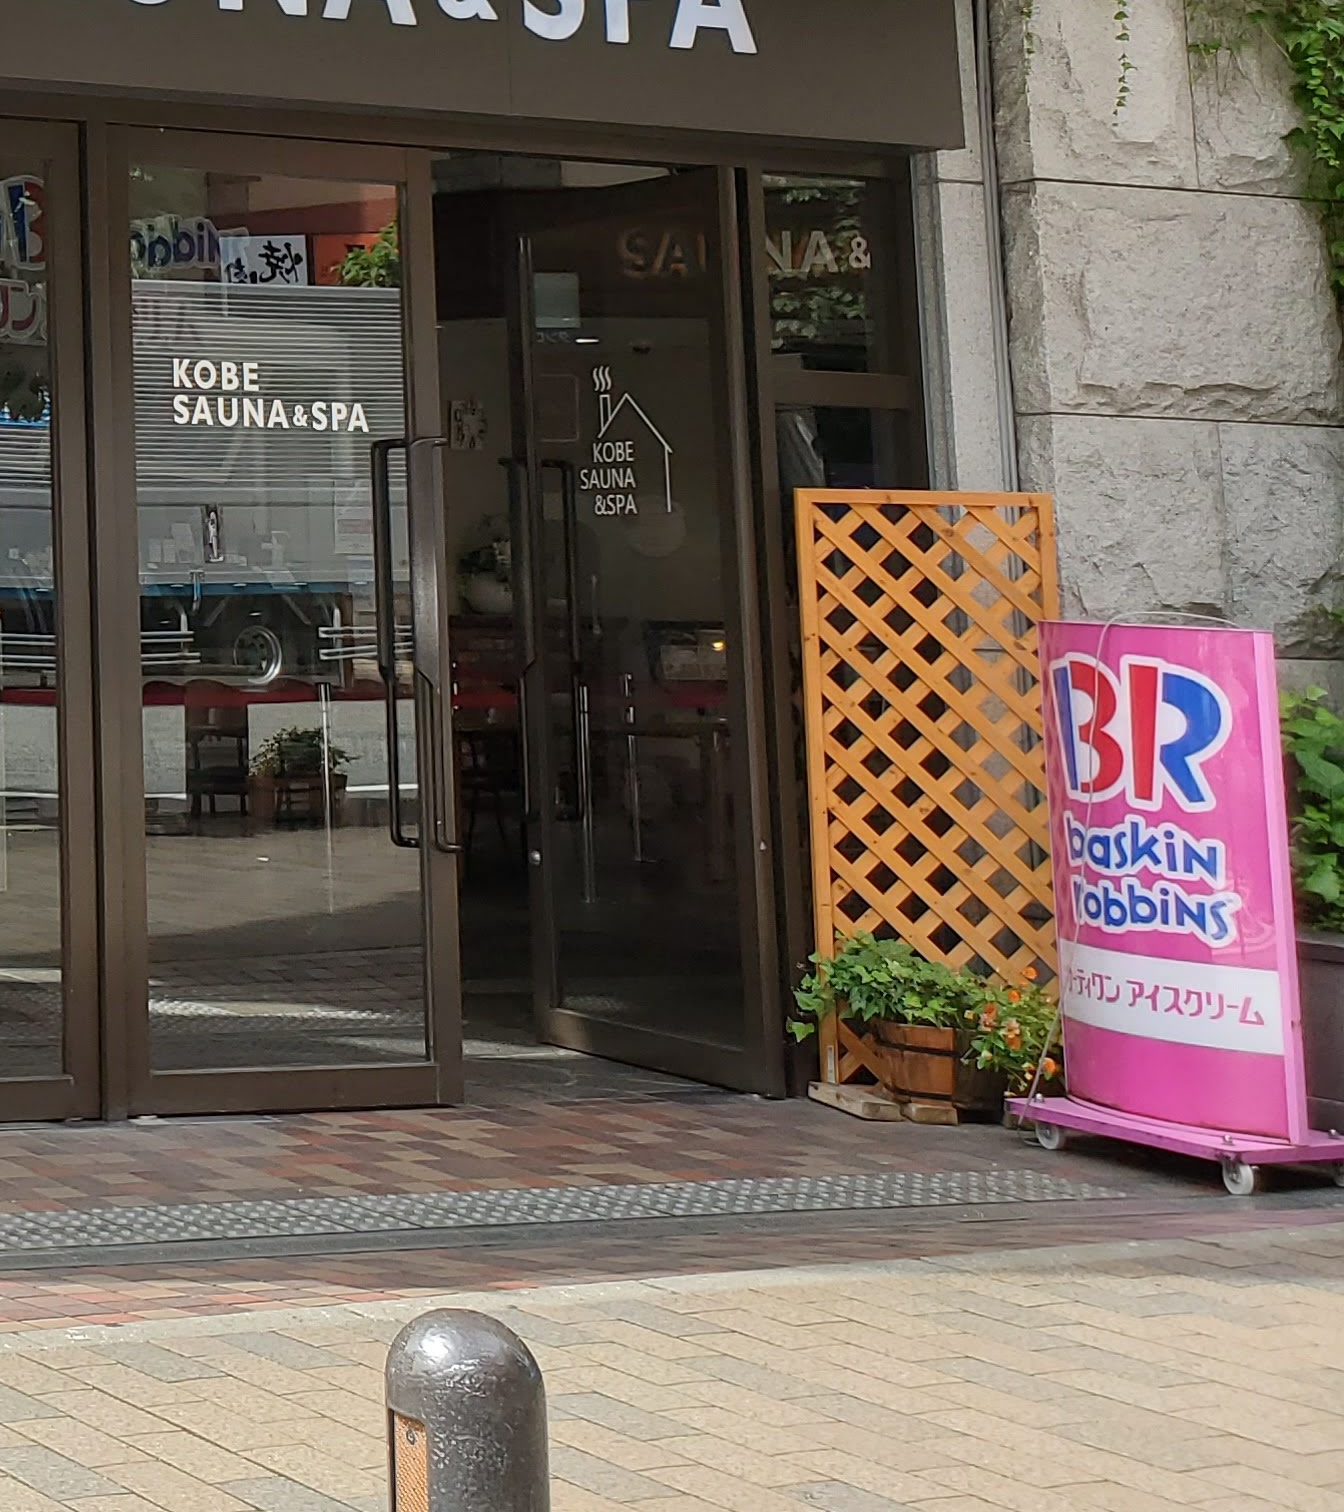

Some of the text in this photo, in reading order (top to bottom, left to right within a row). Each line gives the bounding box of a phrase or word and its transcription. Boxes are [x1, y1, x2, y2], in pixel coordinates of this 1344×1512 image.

[172, 358, 259, 391] KOBE
[592, 441, 635, 464] KOBE
[580, 468, 636, 491] SAUNA
[593, 493, 637, 516] &SPA
[1052, 655, 1229, 808] BR
[1126, 979, 1265, 1026] アイスクリーム
